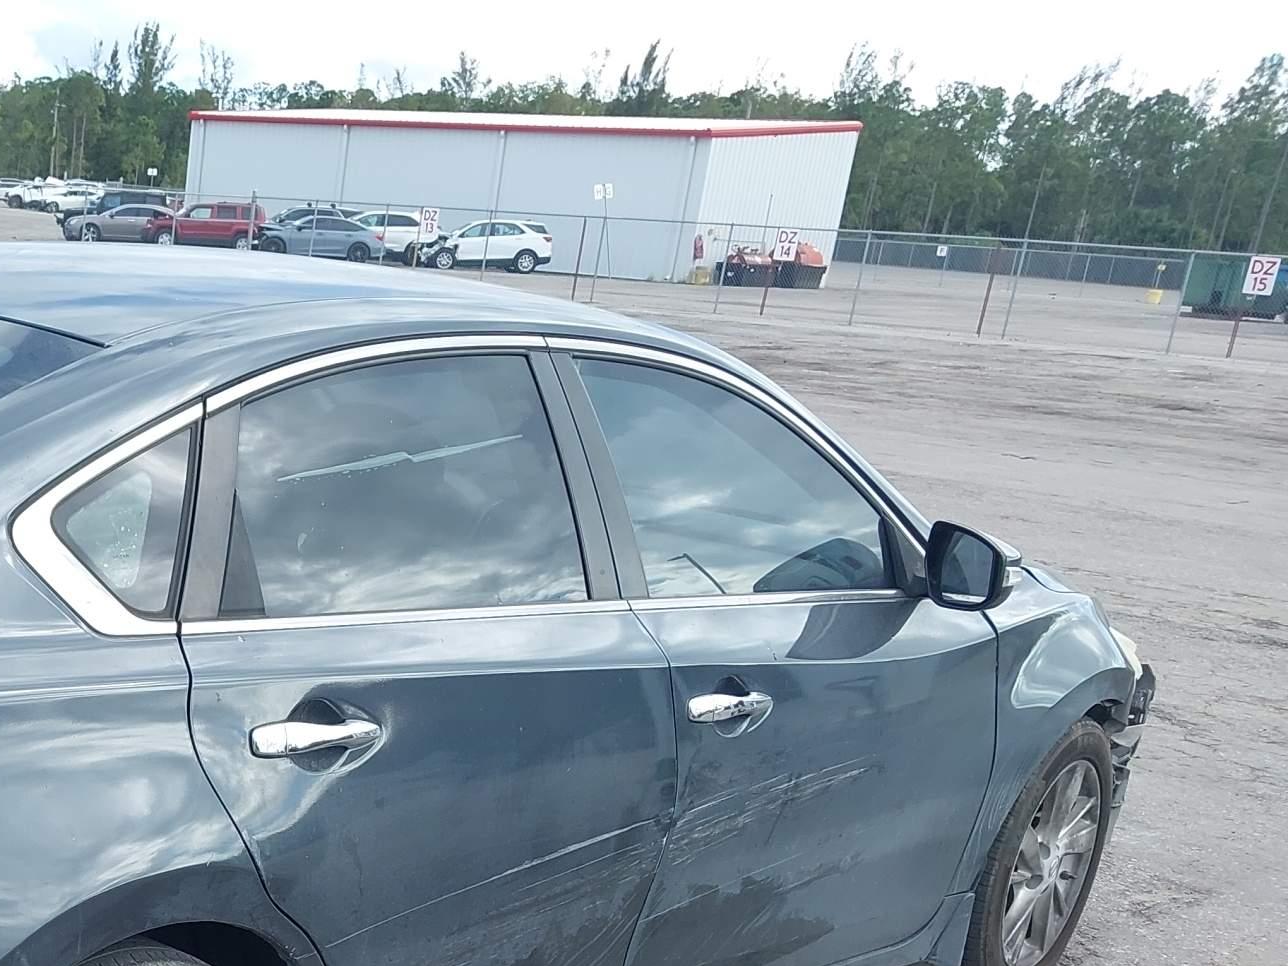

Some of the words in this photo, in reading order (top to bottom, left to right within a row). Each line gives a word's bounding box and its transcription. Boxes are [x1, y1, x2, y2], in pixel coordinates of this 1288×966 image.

[424, 210, 438, 221] DZ
[425, 223, 434, 233] 13
[779, 231, 798, 244] DZ
[780, 246, 791, 258] 14
[1251, 260, 1278, 275] DZ
[1253, 277, 1267, 291] 15
